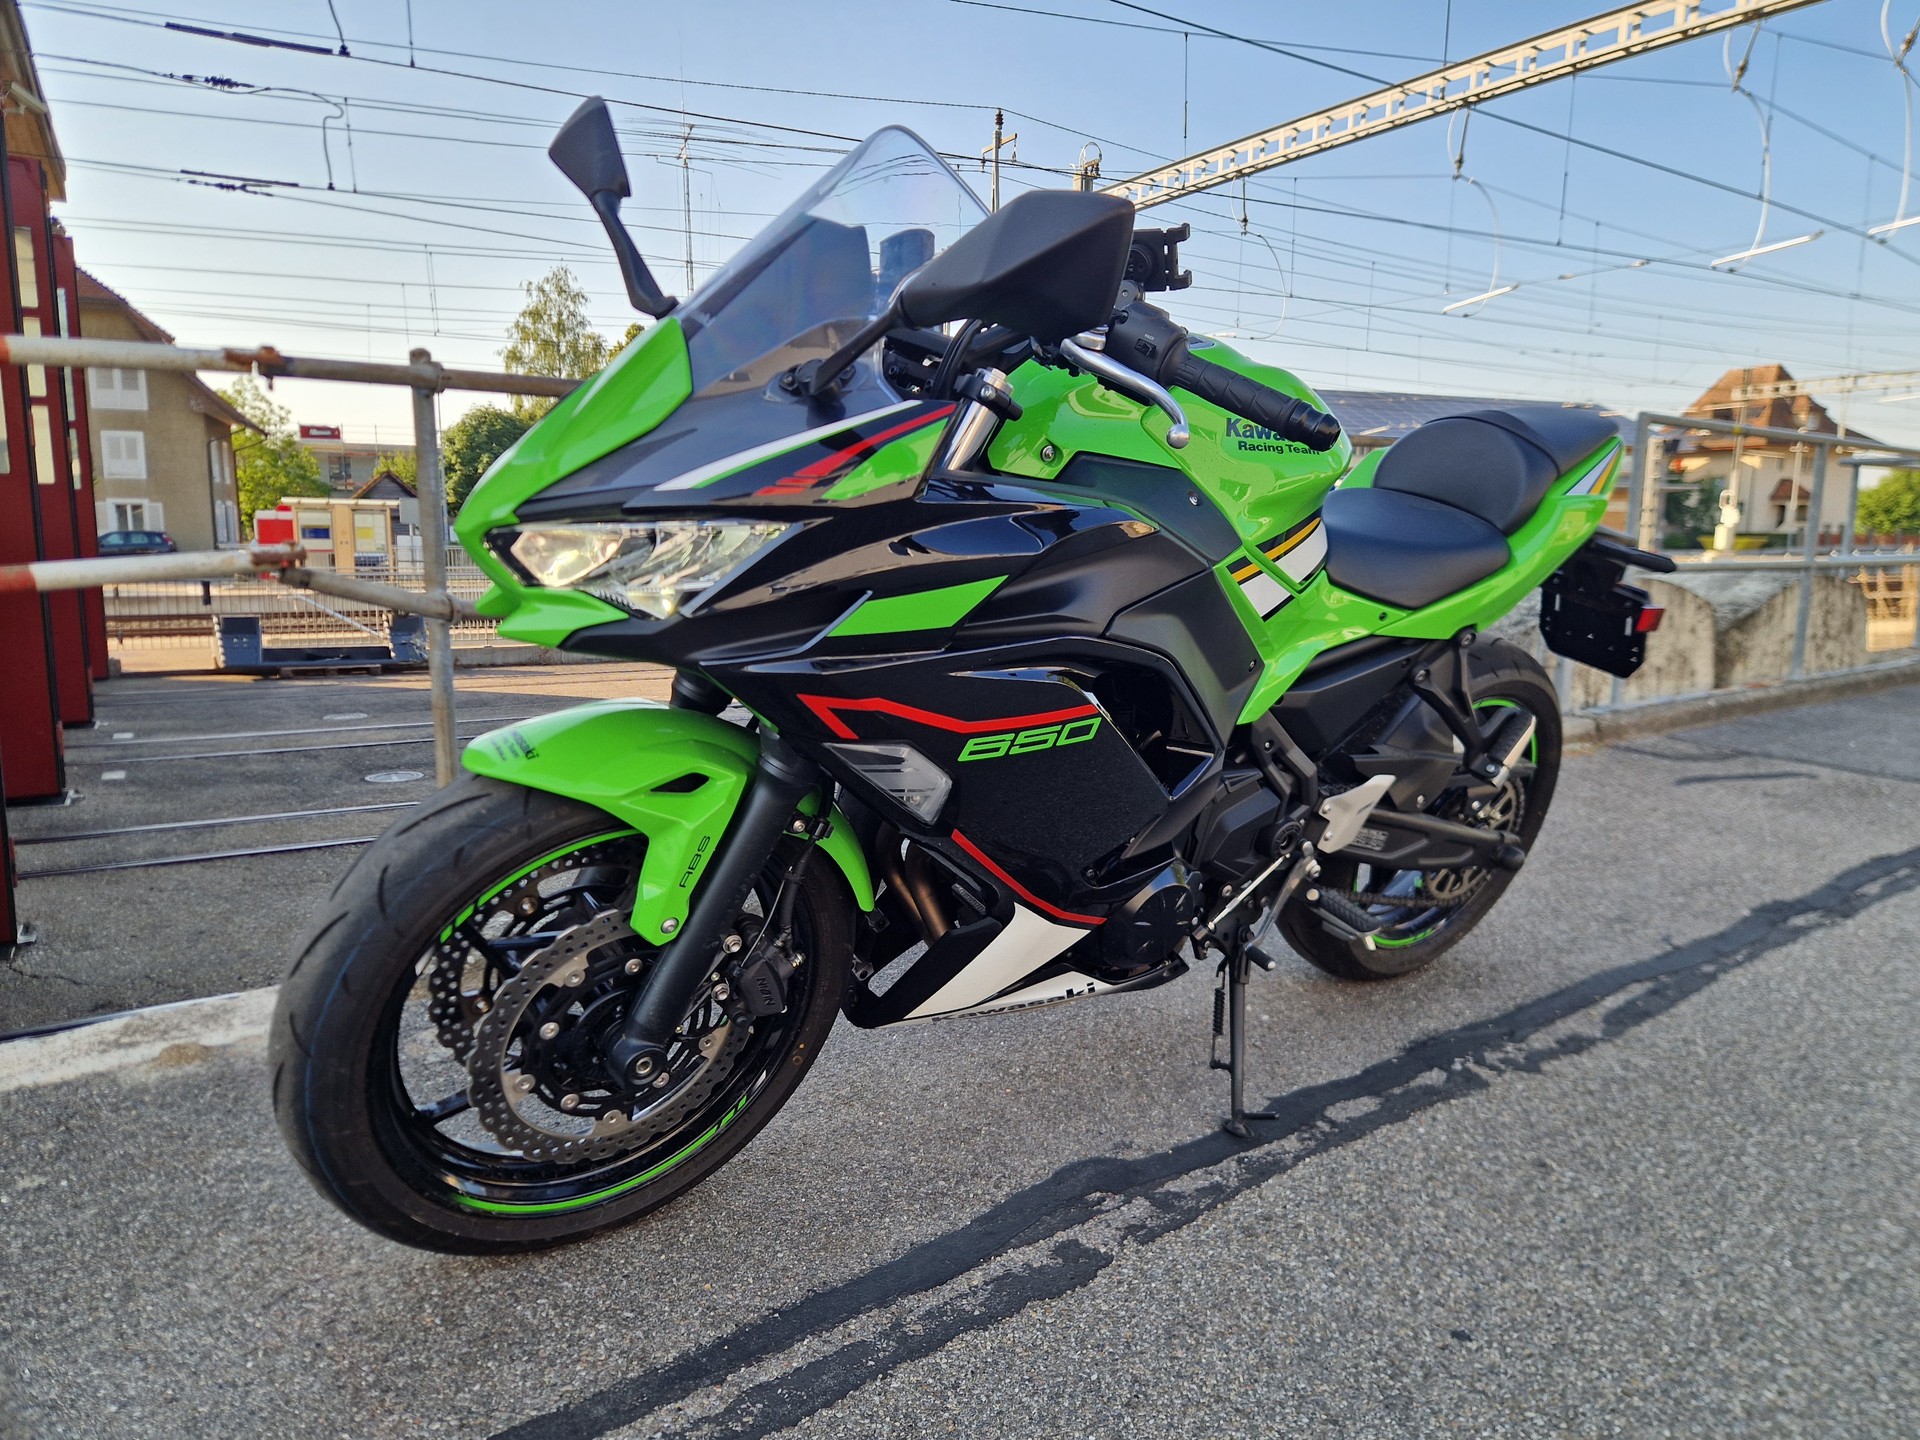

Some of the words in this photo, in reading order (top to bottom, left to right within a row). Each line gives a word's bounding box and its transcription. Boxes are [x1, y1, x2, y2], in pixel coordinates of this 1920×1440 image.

[1238, 441, 1284, 454] Racing
[957, 716, 1102, 762] 650
[679, 835, 711, 888] ABS
